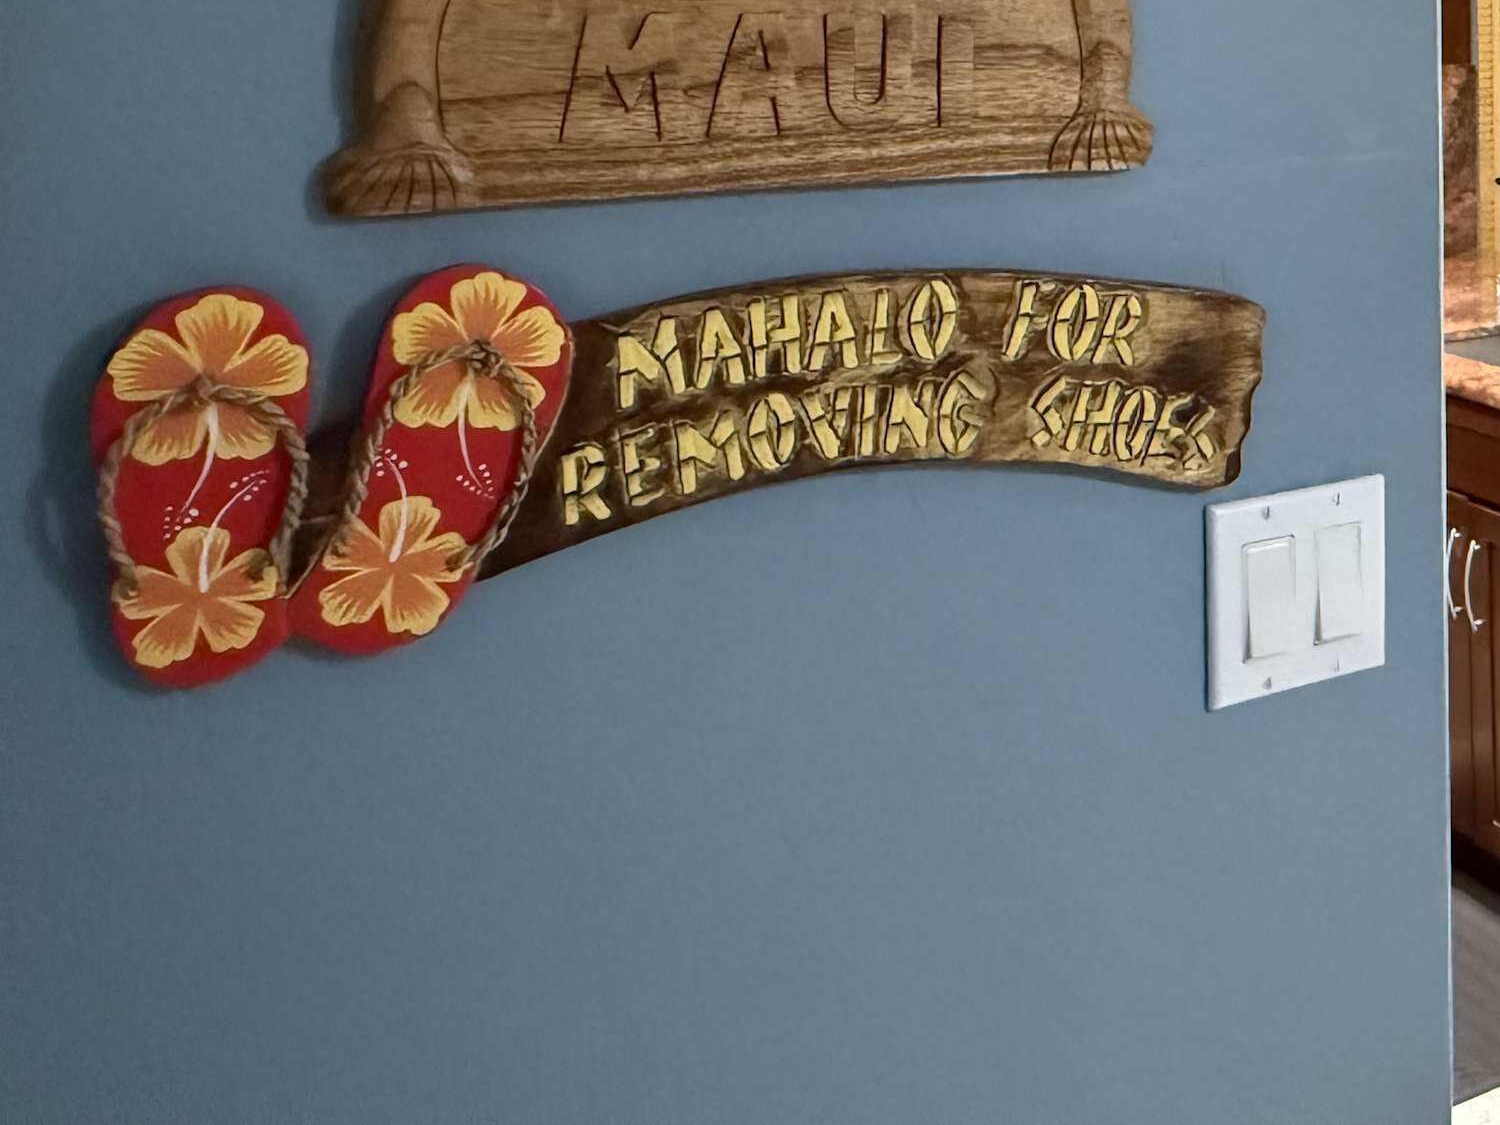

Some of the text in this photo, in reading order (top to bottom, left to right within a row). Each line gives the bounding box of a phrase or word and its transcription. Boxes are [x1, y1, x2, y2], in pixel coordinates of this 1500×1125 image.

[558, 11, 974, 142] MAUI
[615, 279, 1143, 409] MAHALO FOR
[561, 370, 1217, 526] REMOVING SHOES
